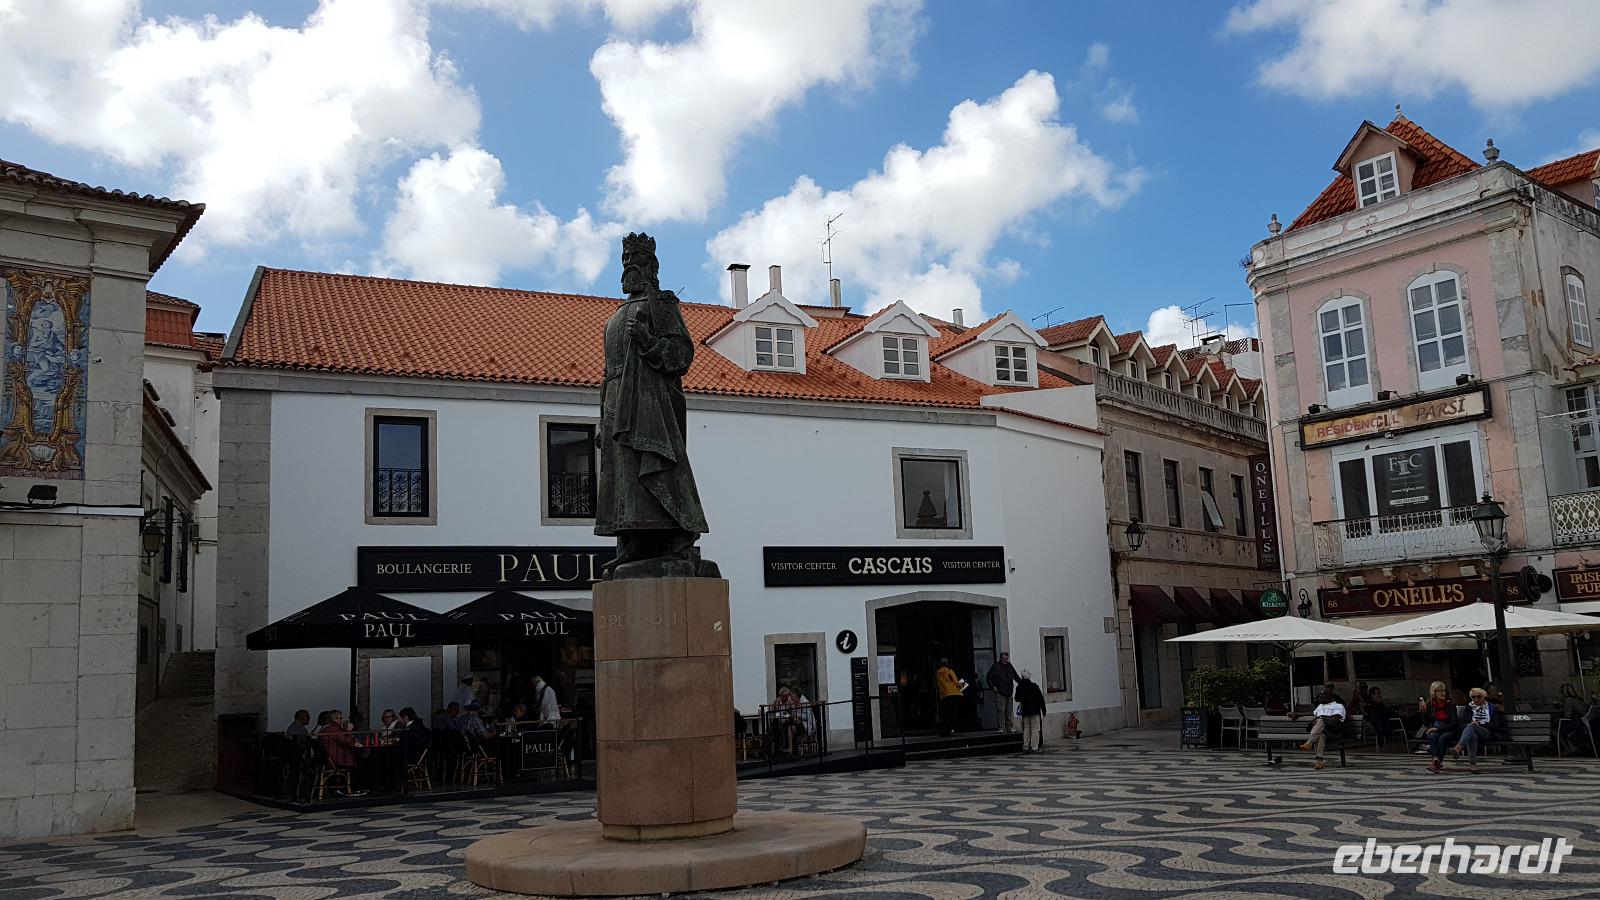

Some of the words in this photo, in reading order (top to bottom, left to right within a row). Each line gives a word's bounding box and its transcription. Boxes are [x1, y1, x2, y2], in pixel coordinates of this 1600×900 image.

[1415, 398, 1466, 422] PARSI
[376, 563, 472, 574] BOULANGERIE
[496, 553, 603, 582] PAUL
[771, 562, 803, 570] VISITOR
[805, 562, 837, 570] CENTER
[848, 557, 933, 574] CASCAIS
[942, 561, 971, 569] VISITOR
[972, 561, 1001, 569] CENTER
[1373, 583, 1465, 608] O'NEILL'S
[363, 623, 417, 638] PAUL
[524, 622, 570, 636] PAUL
[525, 743, 555, 754] PAUL
